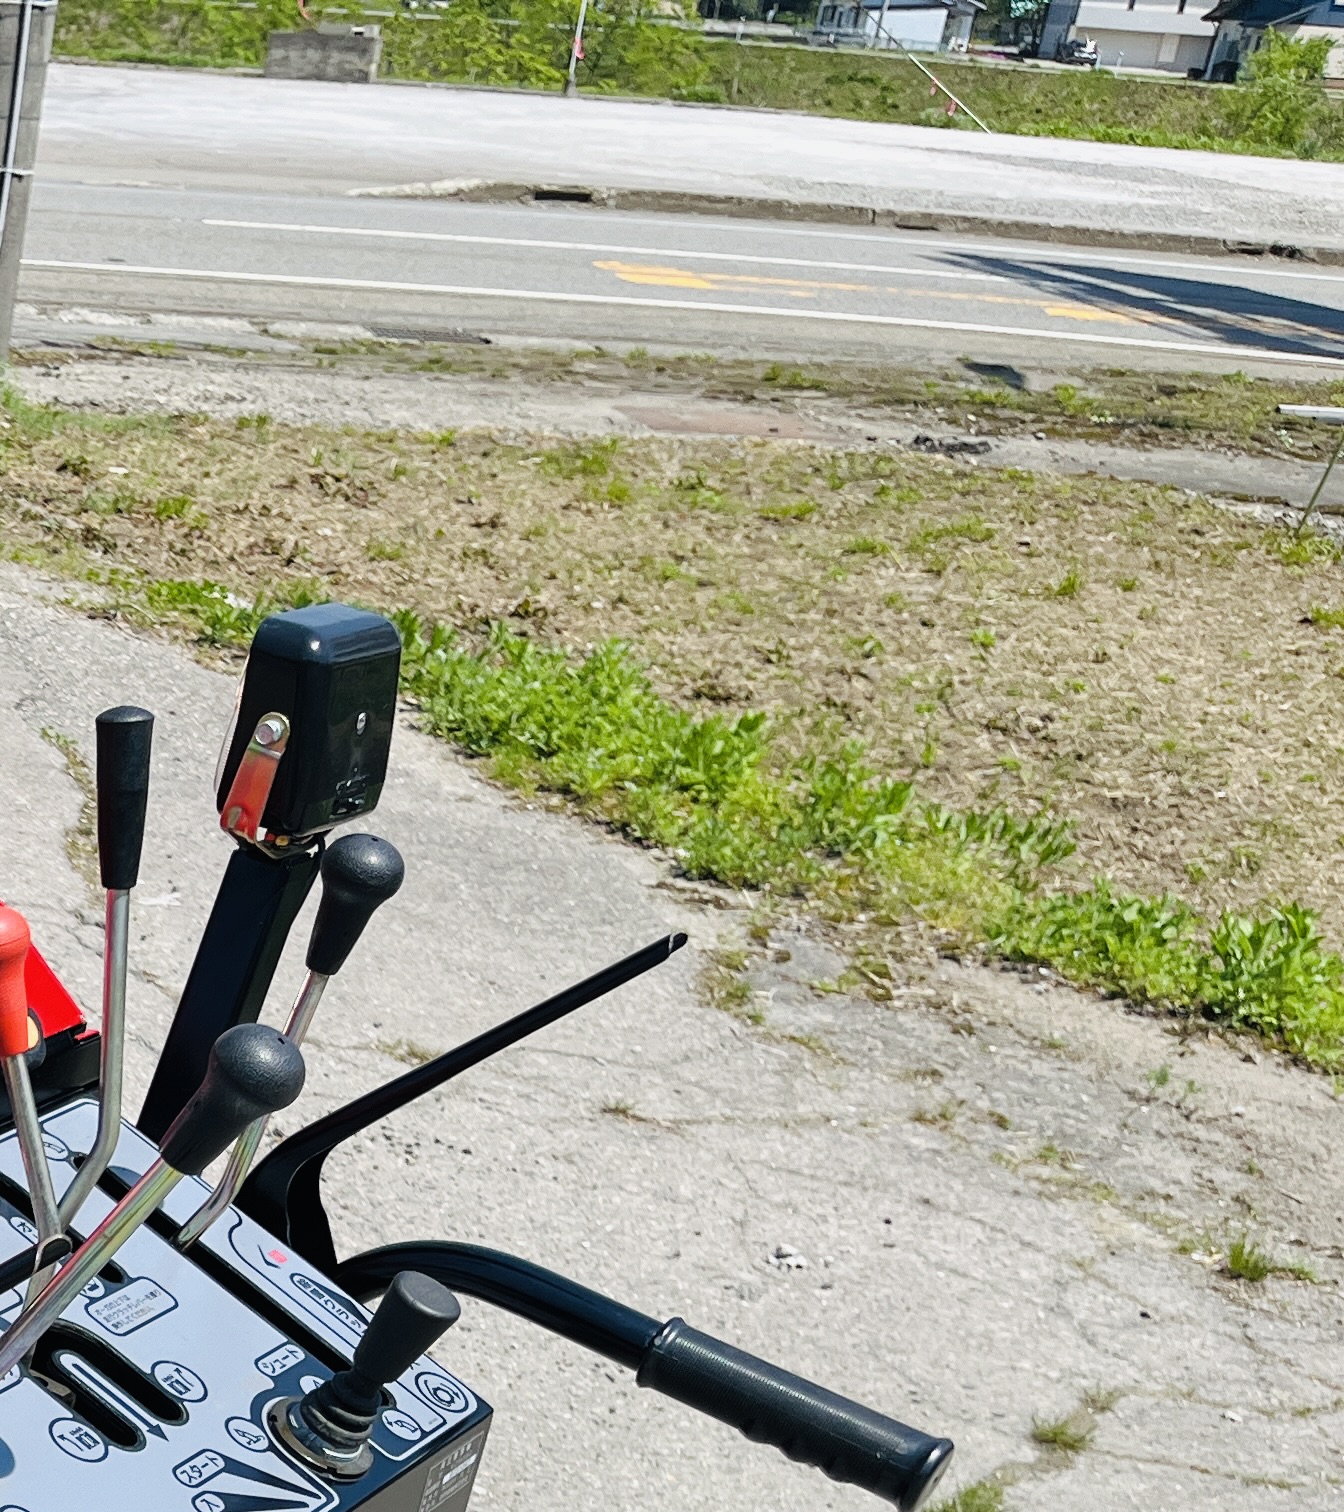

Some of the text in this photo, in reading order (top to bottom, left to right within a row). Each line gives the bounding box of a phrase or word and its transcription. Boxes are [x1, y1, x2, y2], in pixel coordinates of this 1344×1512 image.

[17, 1221, 38, 1238] オー
[296, 1278, 366, 1334] 除雪クラッ
[262, 1346, 300, 1374] シュート
[180, 1455, 224, 1483] スタート
[201, 1496, 221, 1512] 入
